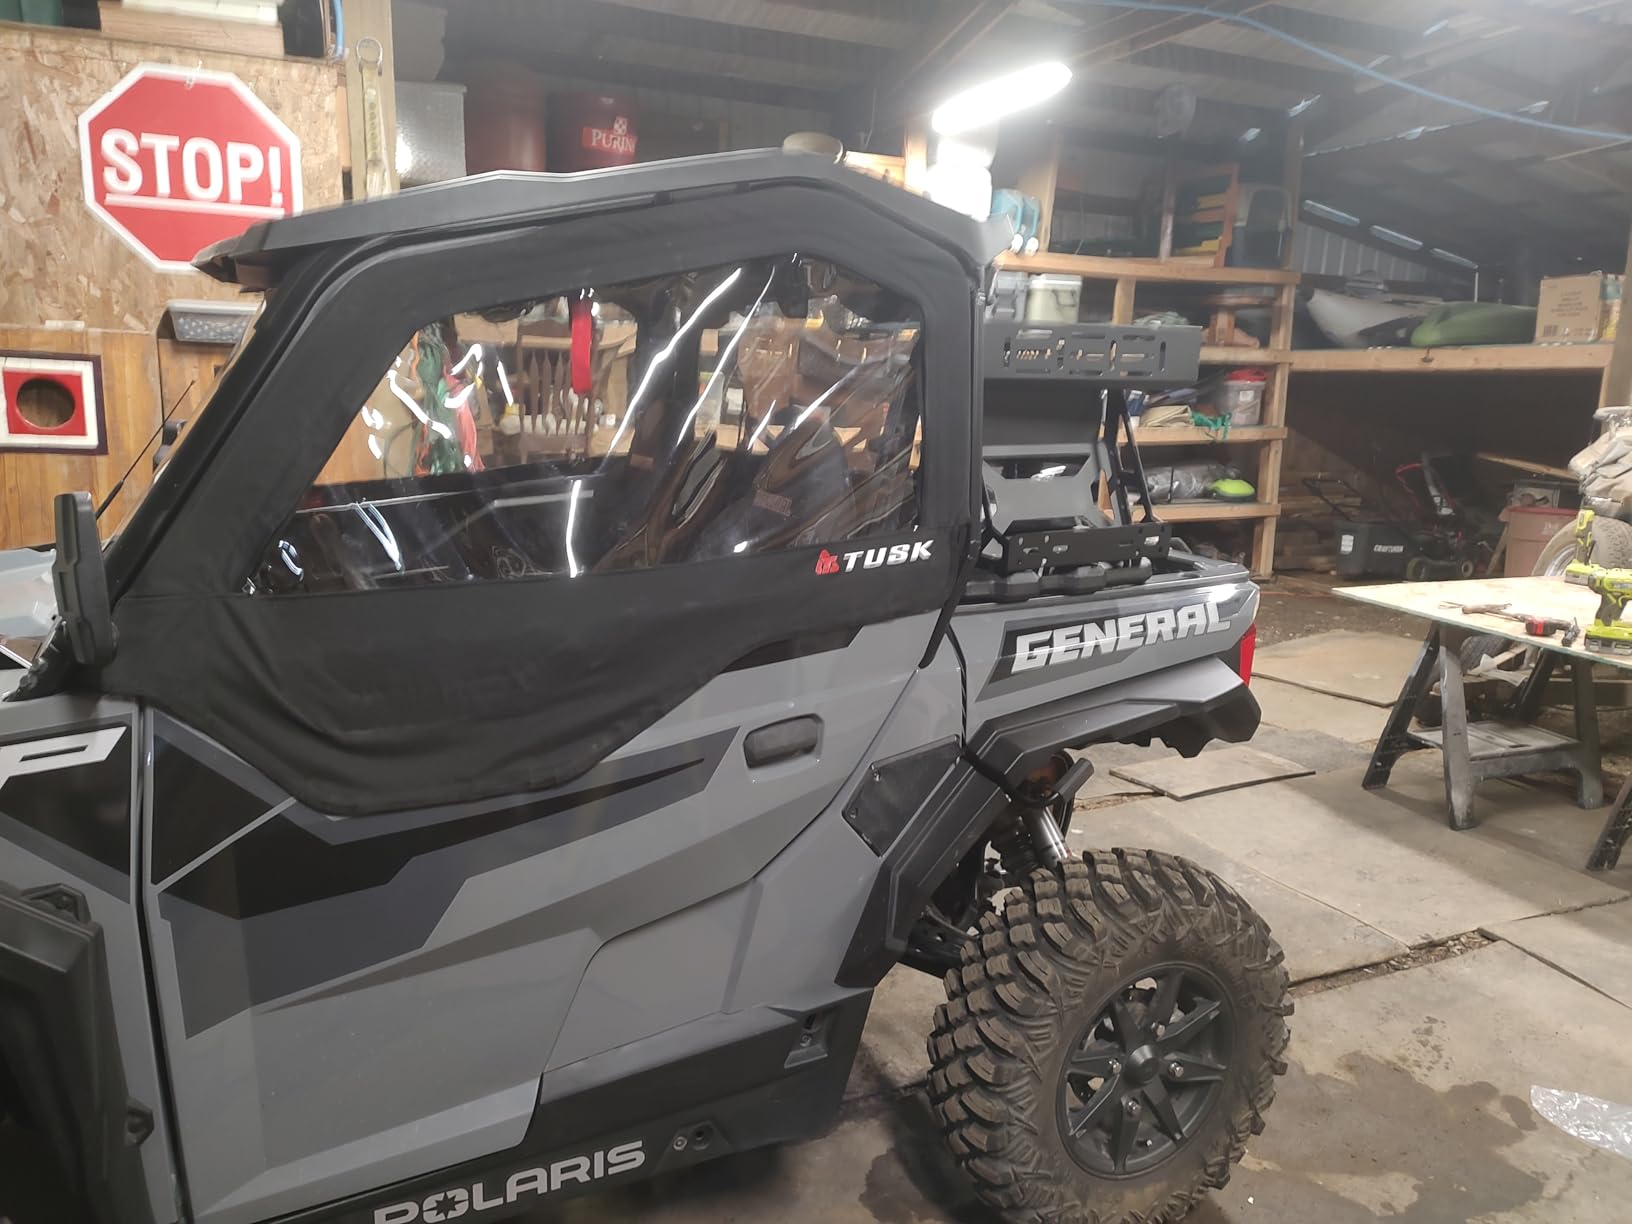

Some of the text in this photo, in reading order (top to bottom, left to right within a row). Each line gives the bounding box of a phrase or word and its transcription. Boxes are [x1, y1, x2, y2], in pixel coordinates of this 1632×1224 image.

[101, 128, 283, 208] STOP!
[843, 539, 934, 572] TUSK
[1373, 544, 1404, 553] CRAFT
[1011, 601, 1231, 674] GENERAL
[374, 1140, 646, 1224] POLARIS
